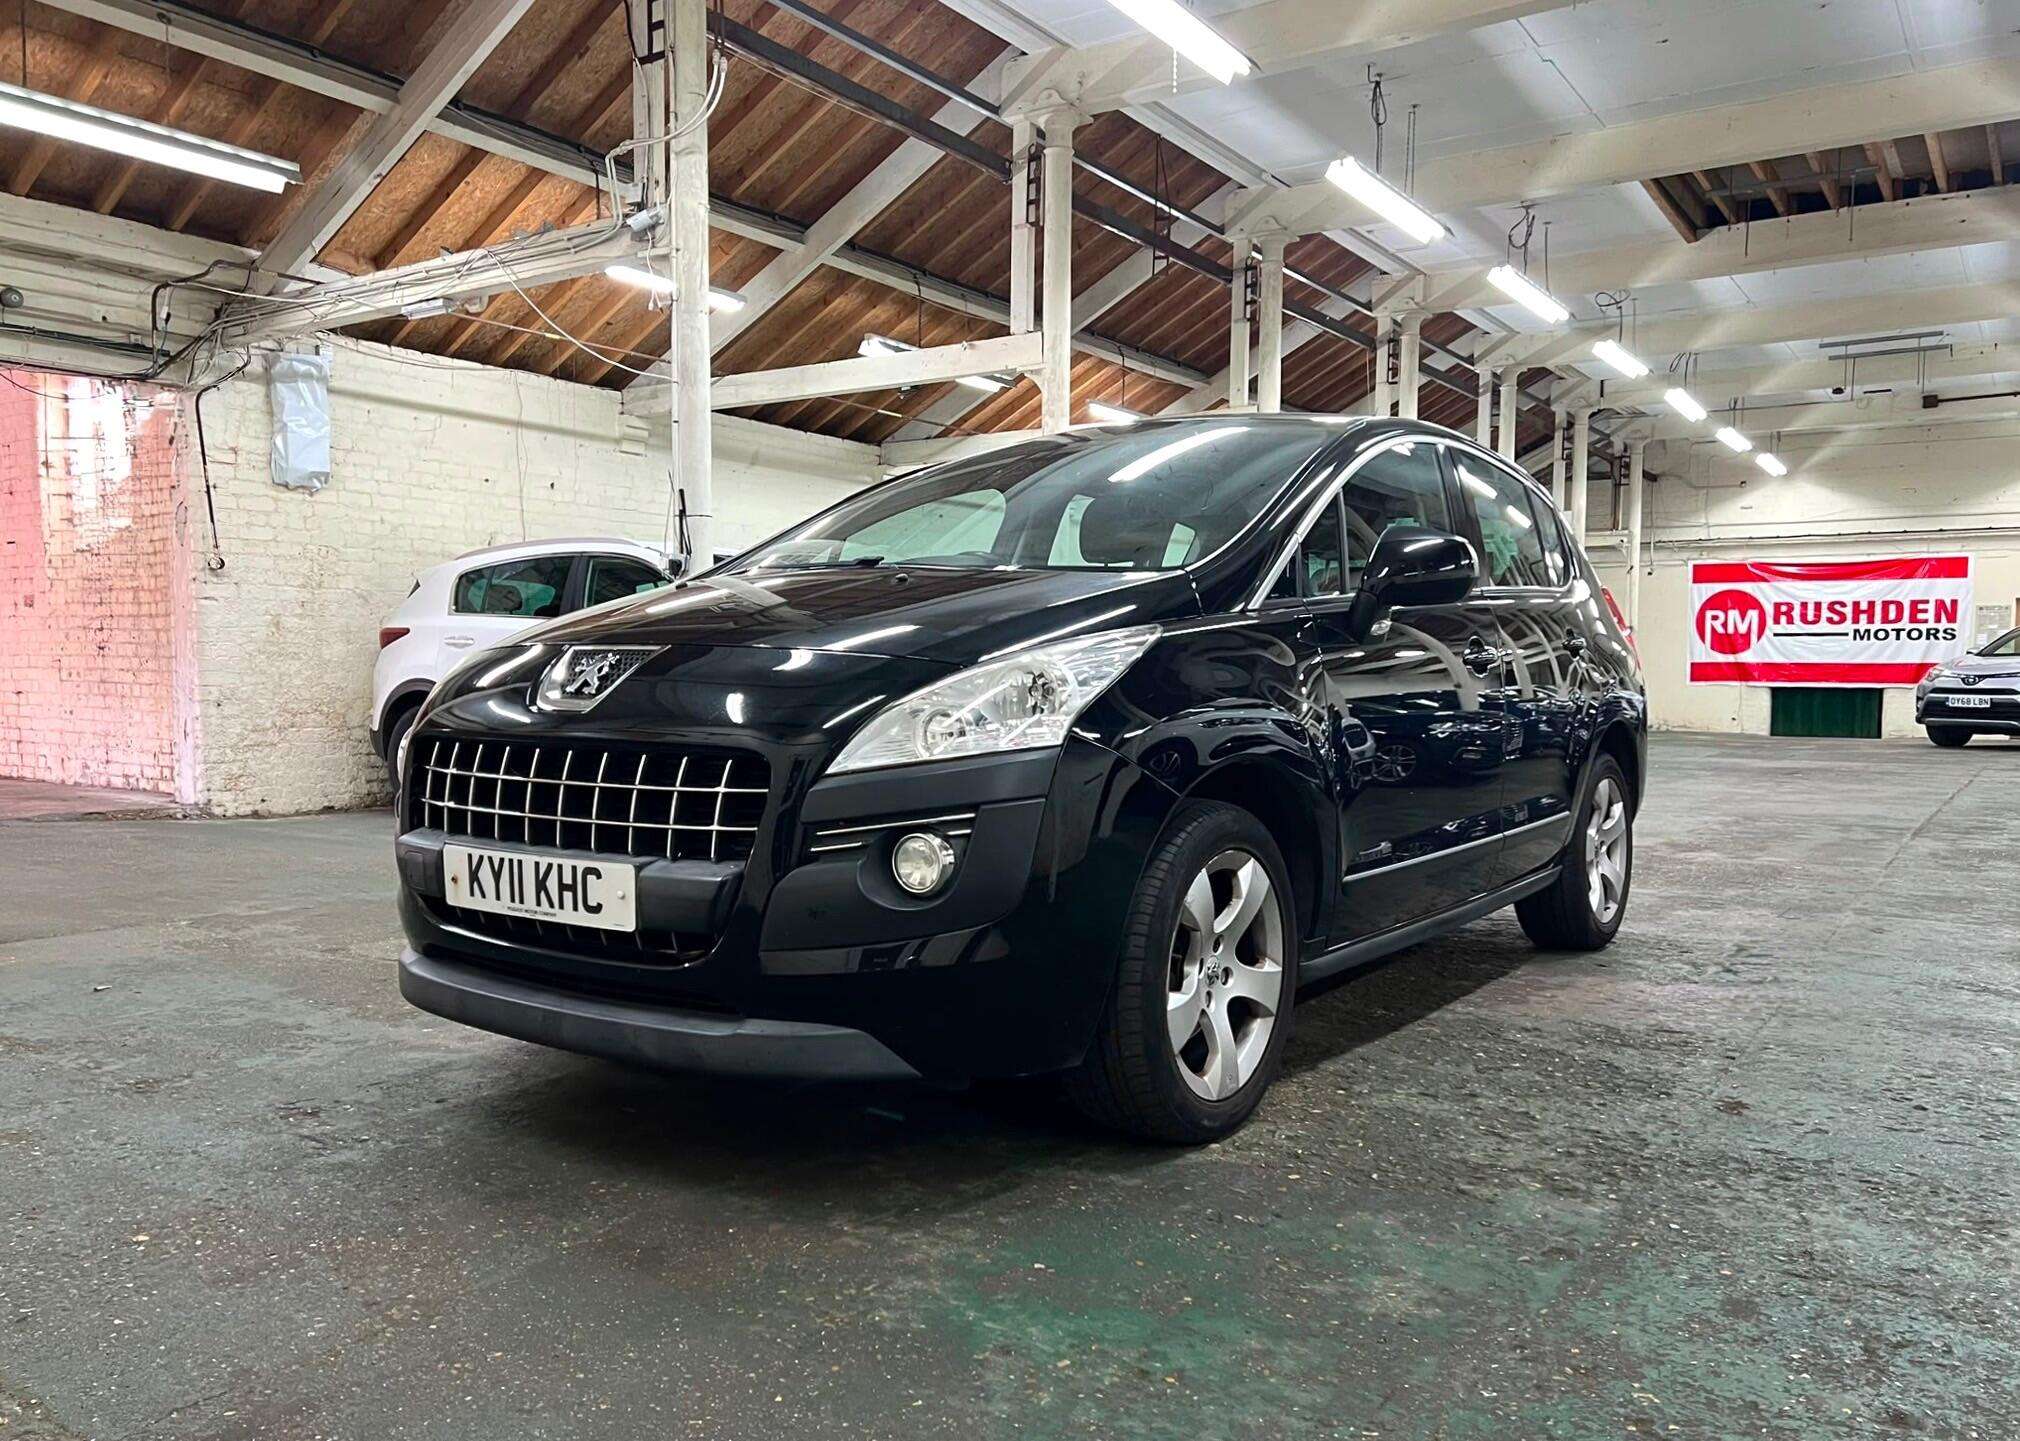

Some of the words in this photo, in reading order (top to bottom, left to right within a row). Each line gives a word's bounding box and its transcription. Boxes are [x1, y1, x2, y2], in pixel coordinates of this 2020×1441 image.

[1705, 608, 1760, 647] RM
[1772, 598, 1959, 625] RUSHDEN
[1852, 628, 1957, 641] MOTORS
[467, 853, 524, 905] KY11
[533, 860, 603, 915] KHC
